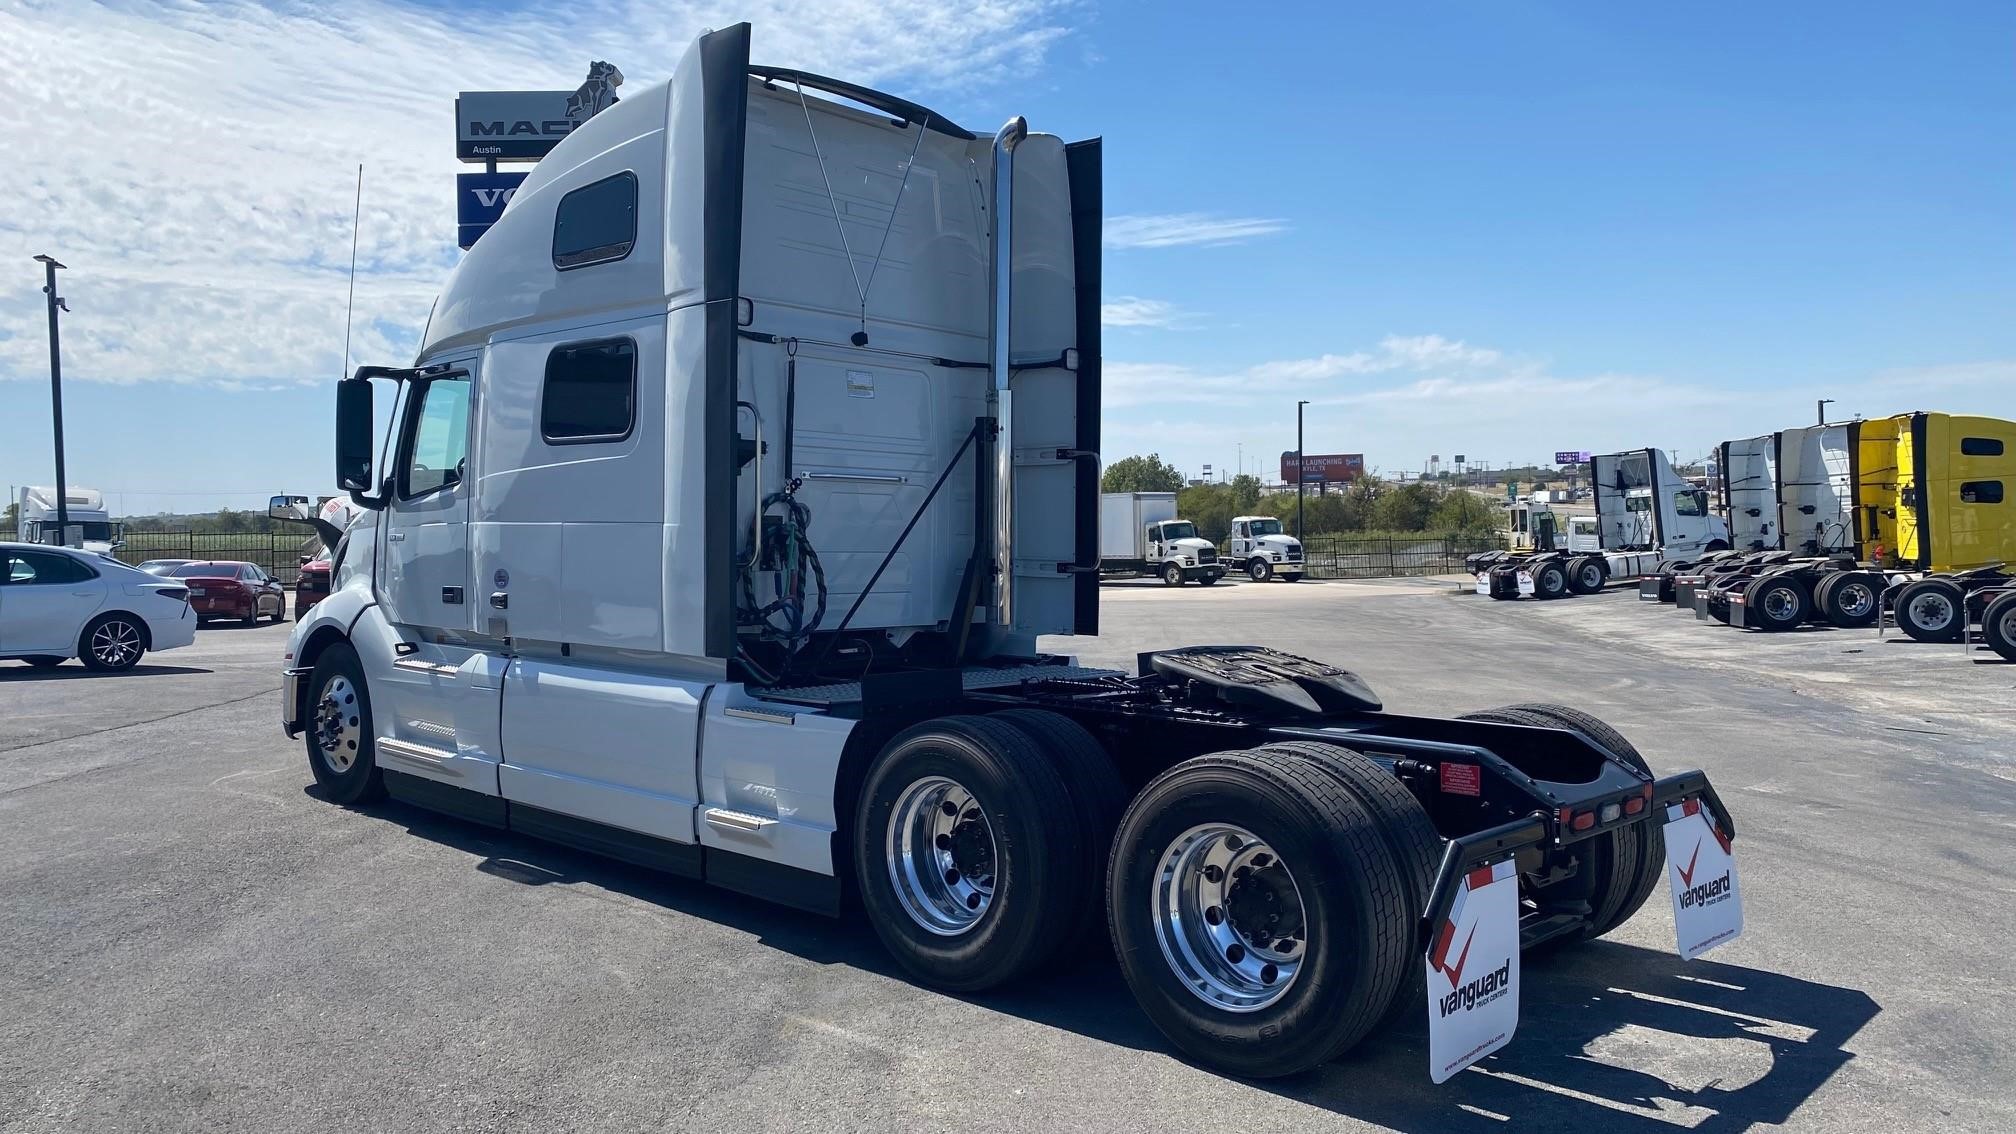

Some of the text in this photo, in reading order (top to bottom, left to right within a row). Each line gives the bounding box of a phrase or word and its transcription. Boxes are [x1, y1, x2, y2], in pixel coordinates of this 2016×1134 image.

[472, 145, 502, 154] Austin
[1286, 459, 1304, 467] HAR
[1306, 458, 1342, 466] LAUNCHING
[1679, 869, 1730, 910] vanguard
[1439, 957, 1511, 1018] vanguard
[1476, 987, 1508, 1009] TRUCK CENTERS
